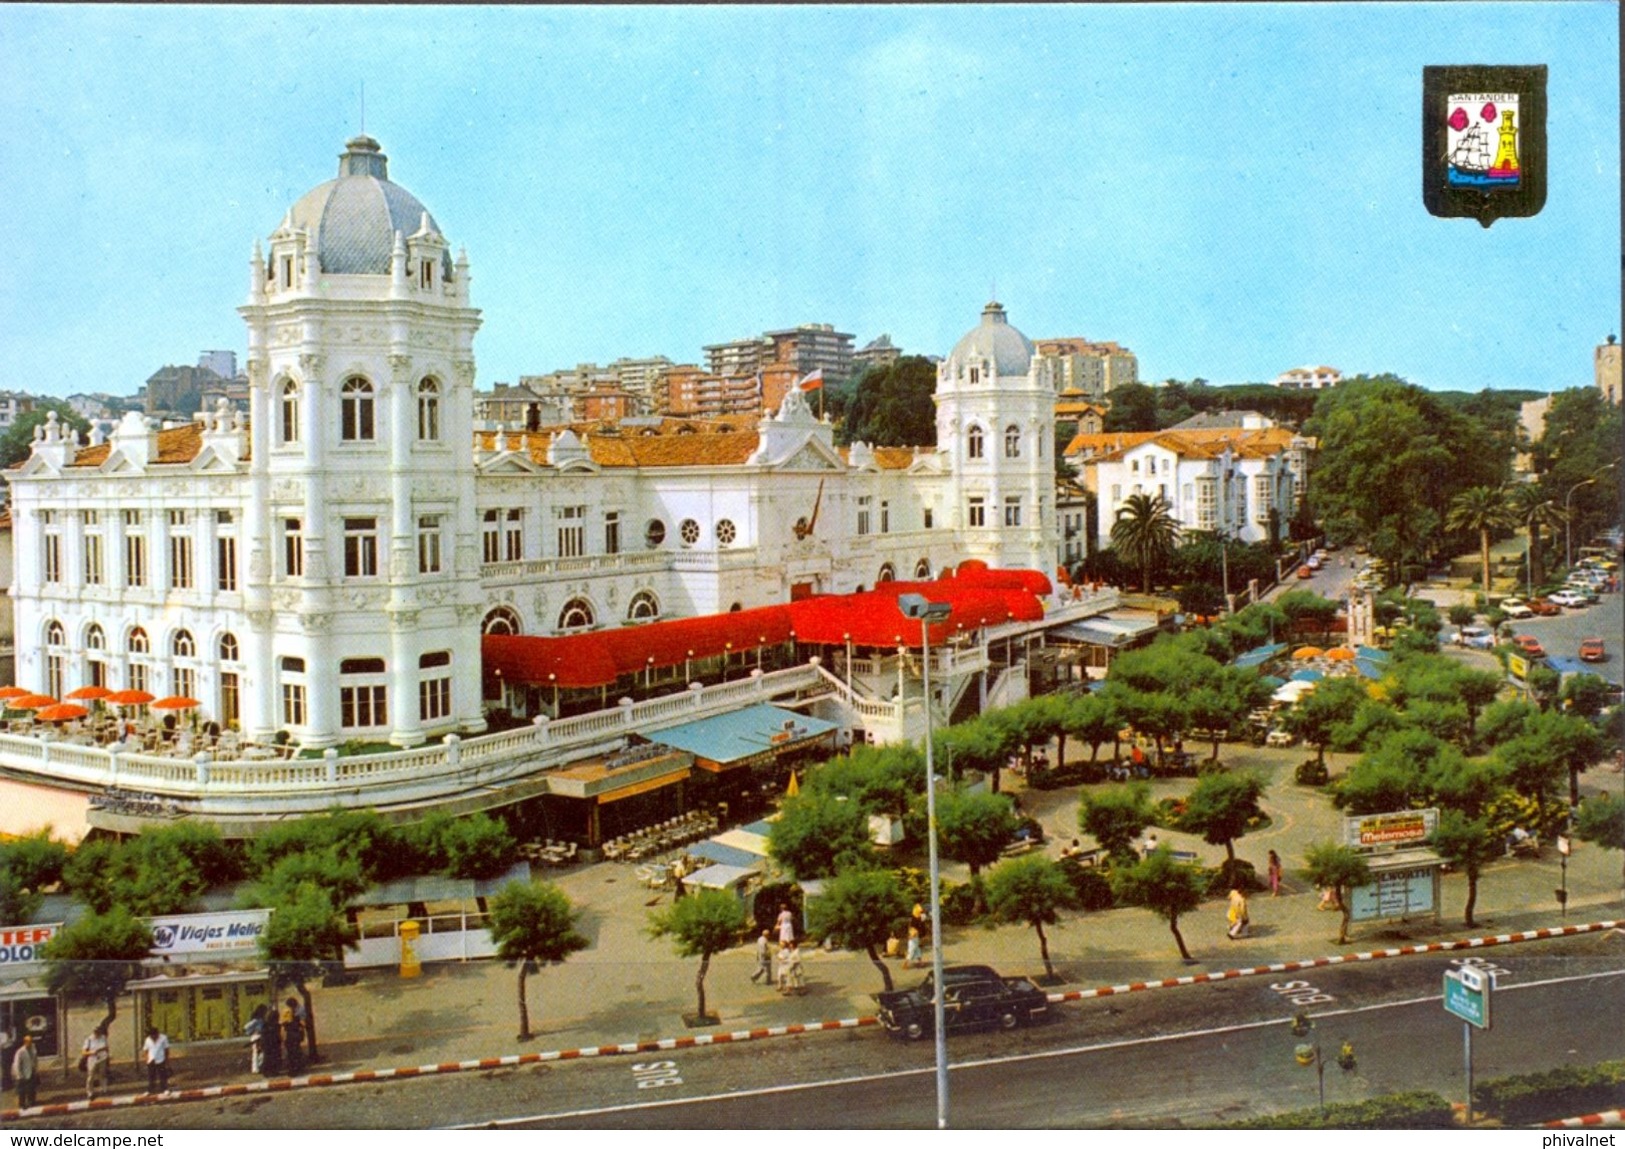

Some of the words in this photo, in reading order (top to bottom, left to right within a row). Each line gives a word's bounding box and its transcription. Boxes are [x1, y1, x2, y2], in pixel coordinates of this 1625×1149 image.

[180, 925, 225, 942] Viajes
[1269, 980, 1334, 1006] BUS
[631, 1060, 684, 1090] BUS
